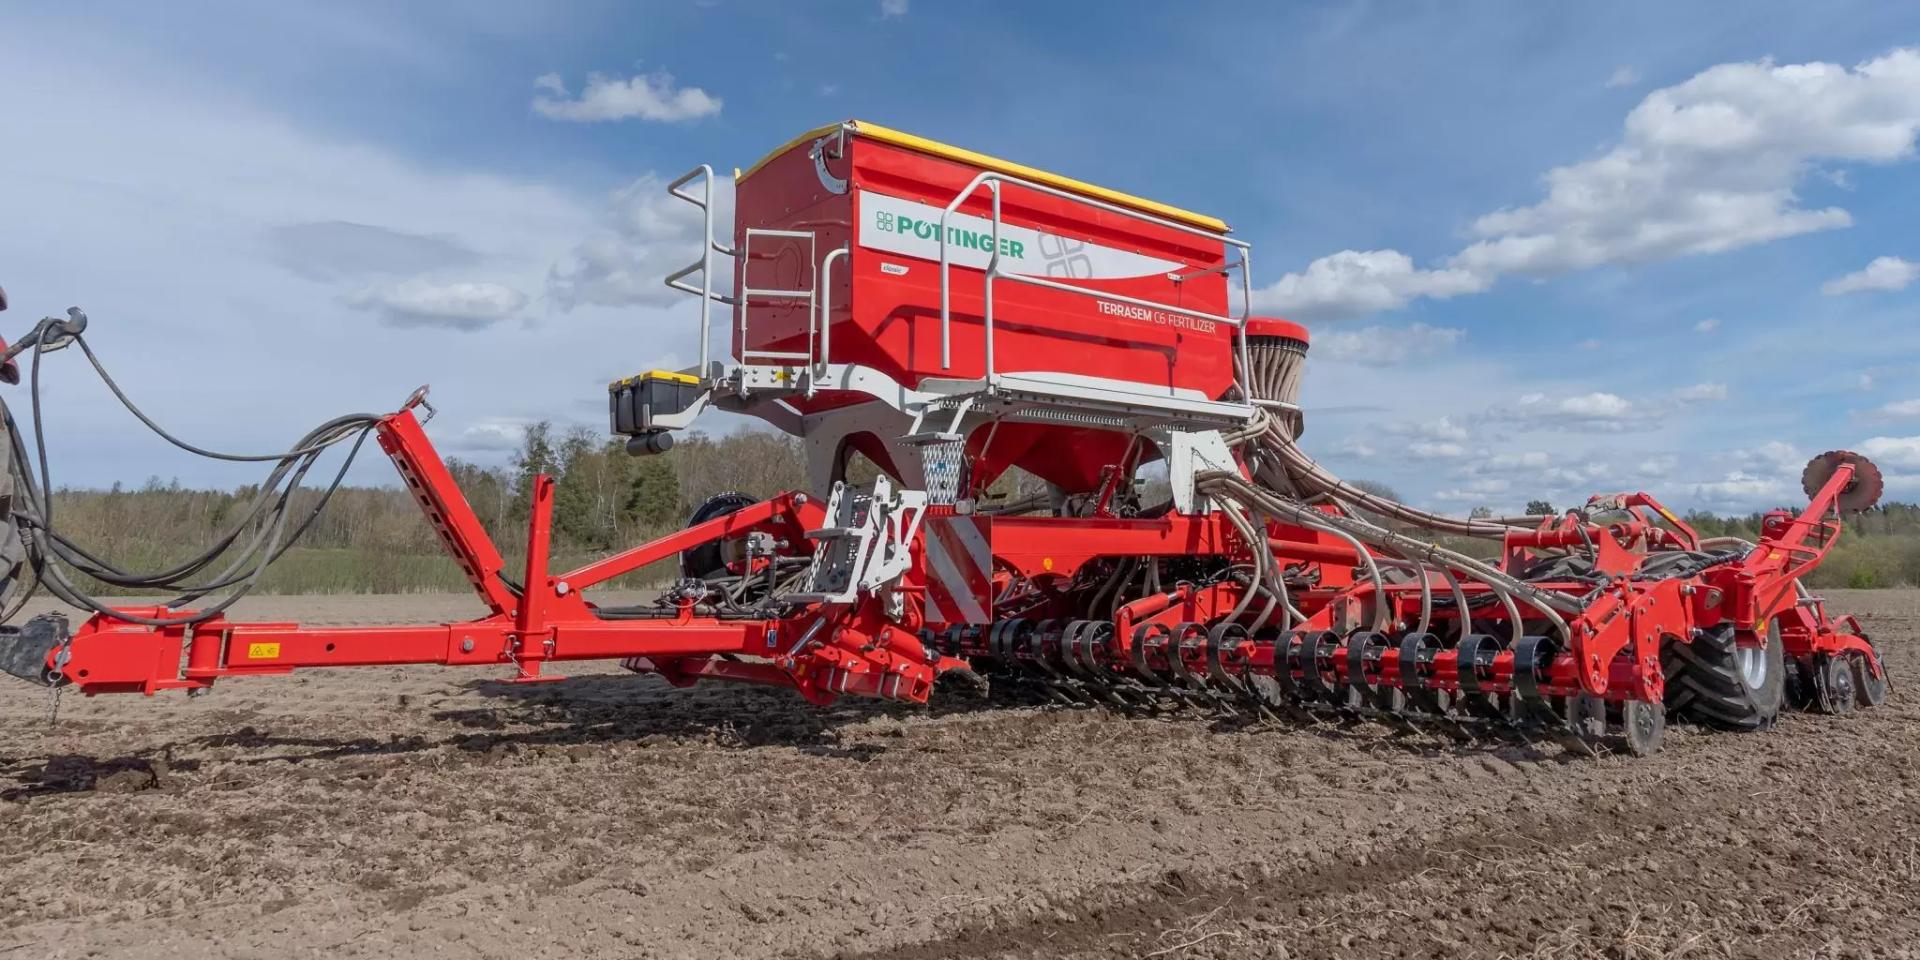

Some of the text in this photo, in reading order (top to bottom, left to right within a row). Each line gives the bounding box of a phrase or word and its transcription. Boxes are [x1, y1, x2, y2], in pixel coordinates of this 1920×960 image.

[1097, 300, 1216, 334] TERRASEM C6 FERTILIZER
